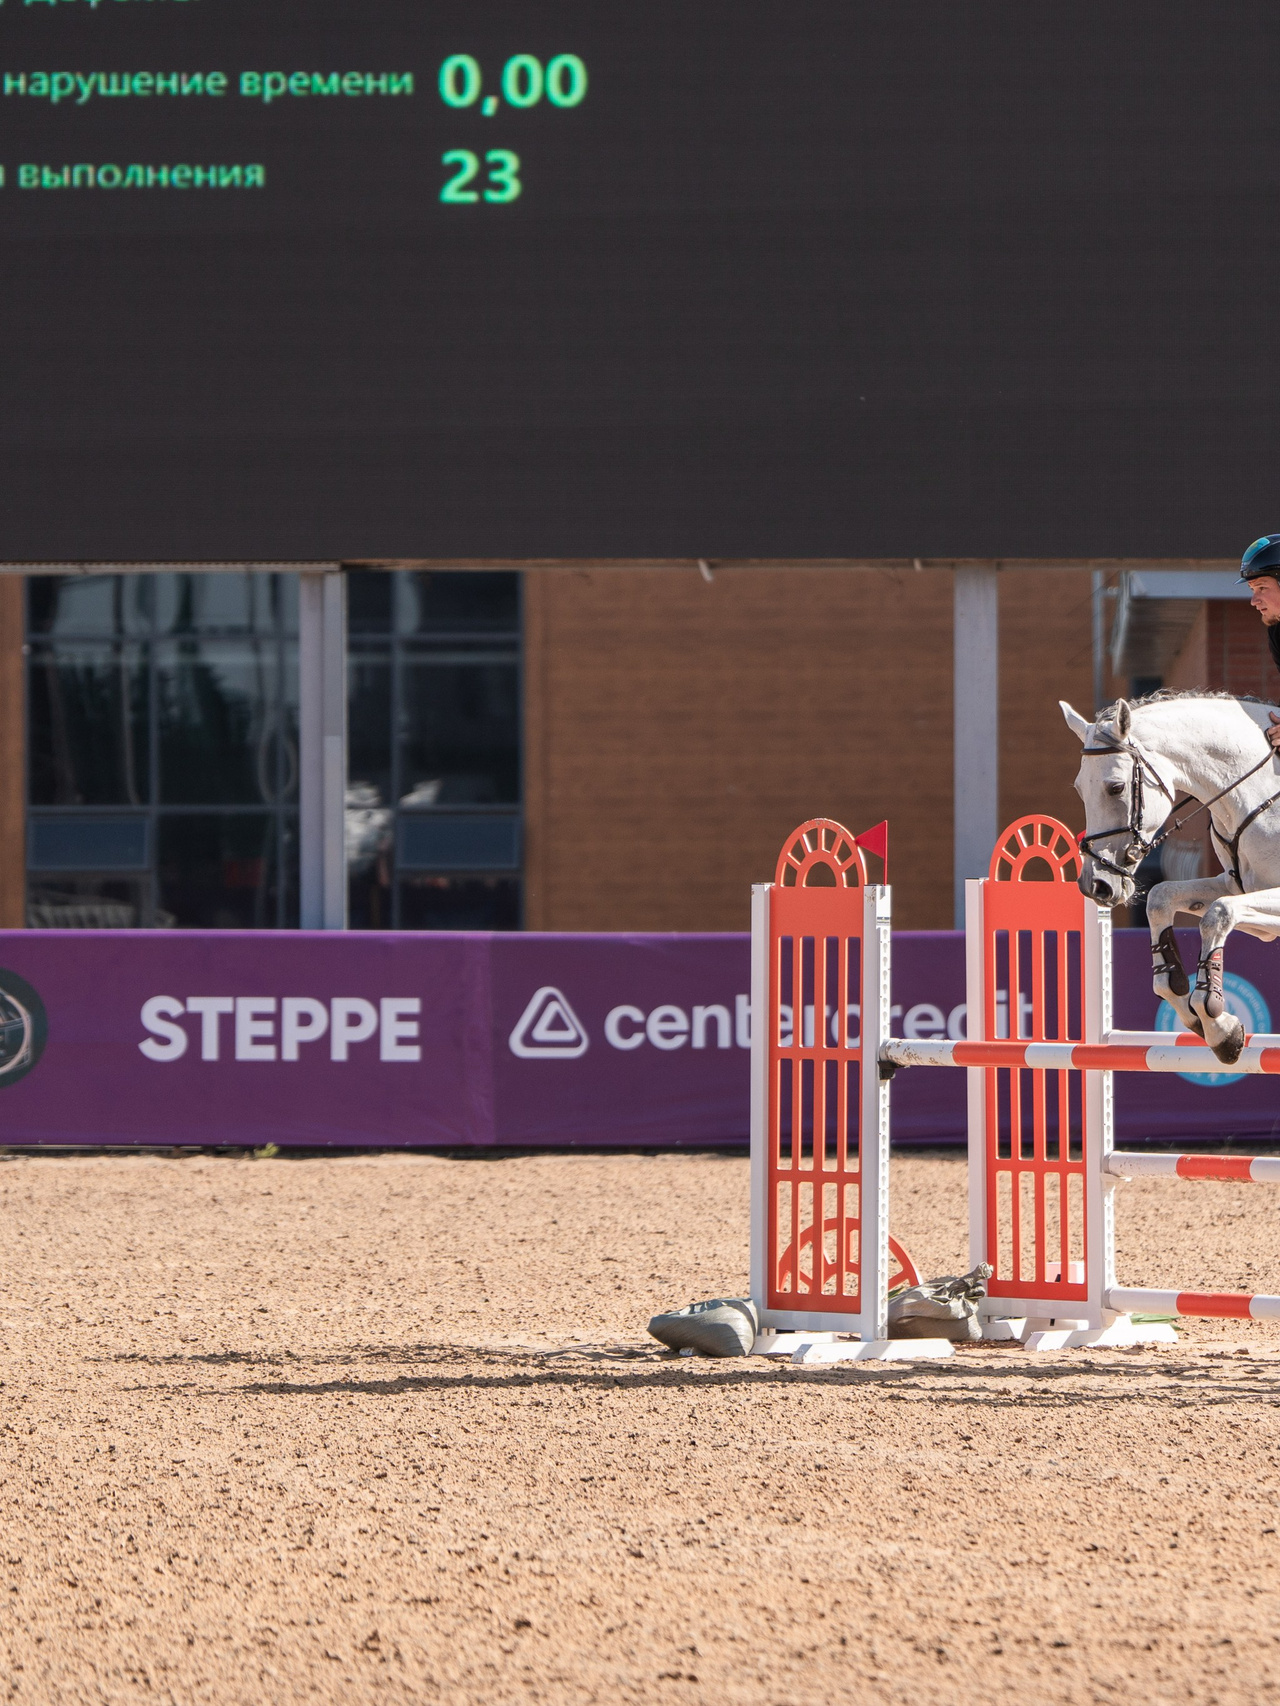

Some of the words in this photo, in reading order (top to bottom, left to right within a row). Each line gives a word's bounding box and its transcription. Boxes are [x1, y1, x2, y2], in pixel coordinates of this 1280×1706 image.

[4, 72, 227, 103] нарушение
[241, 72, 414, 103] времени
[438, 53, 588, 117] 0,00
[18, 164, 266, 189] выполнения
[440, 150, 521, 203] 23
[138, 995, 421, 1062] STEPPE
